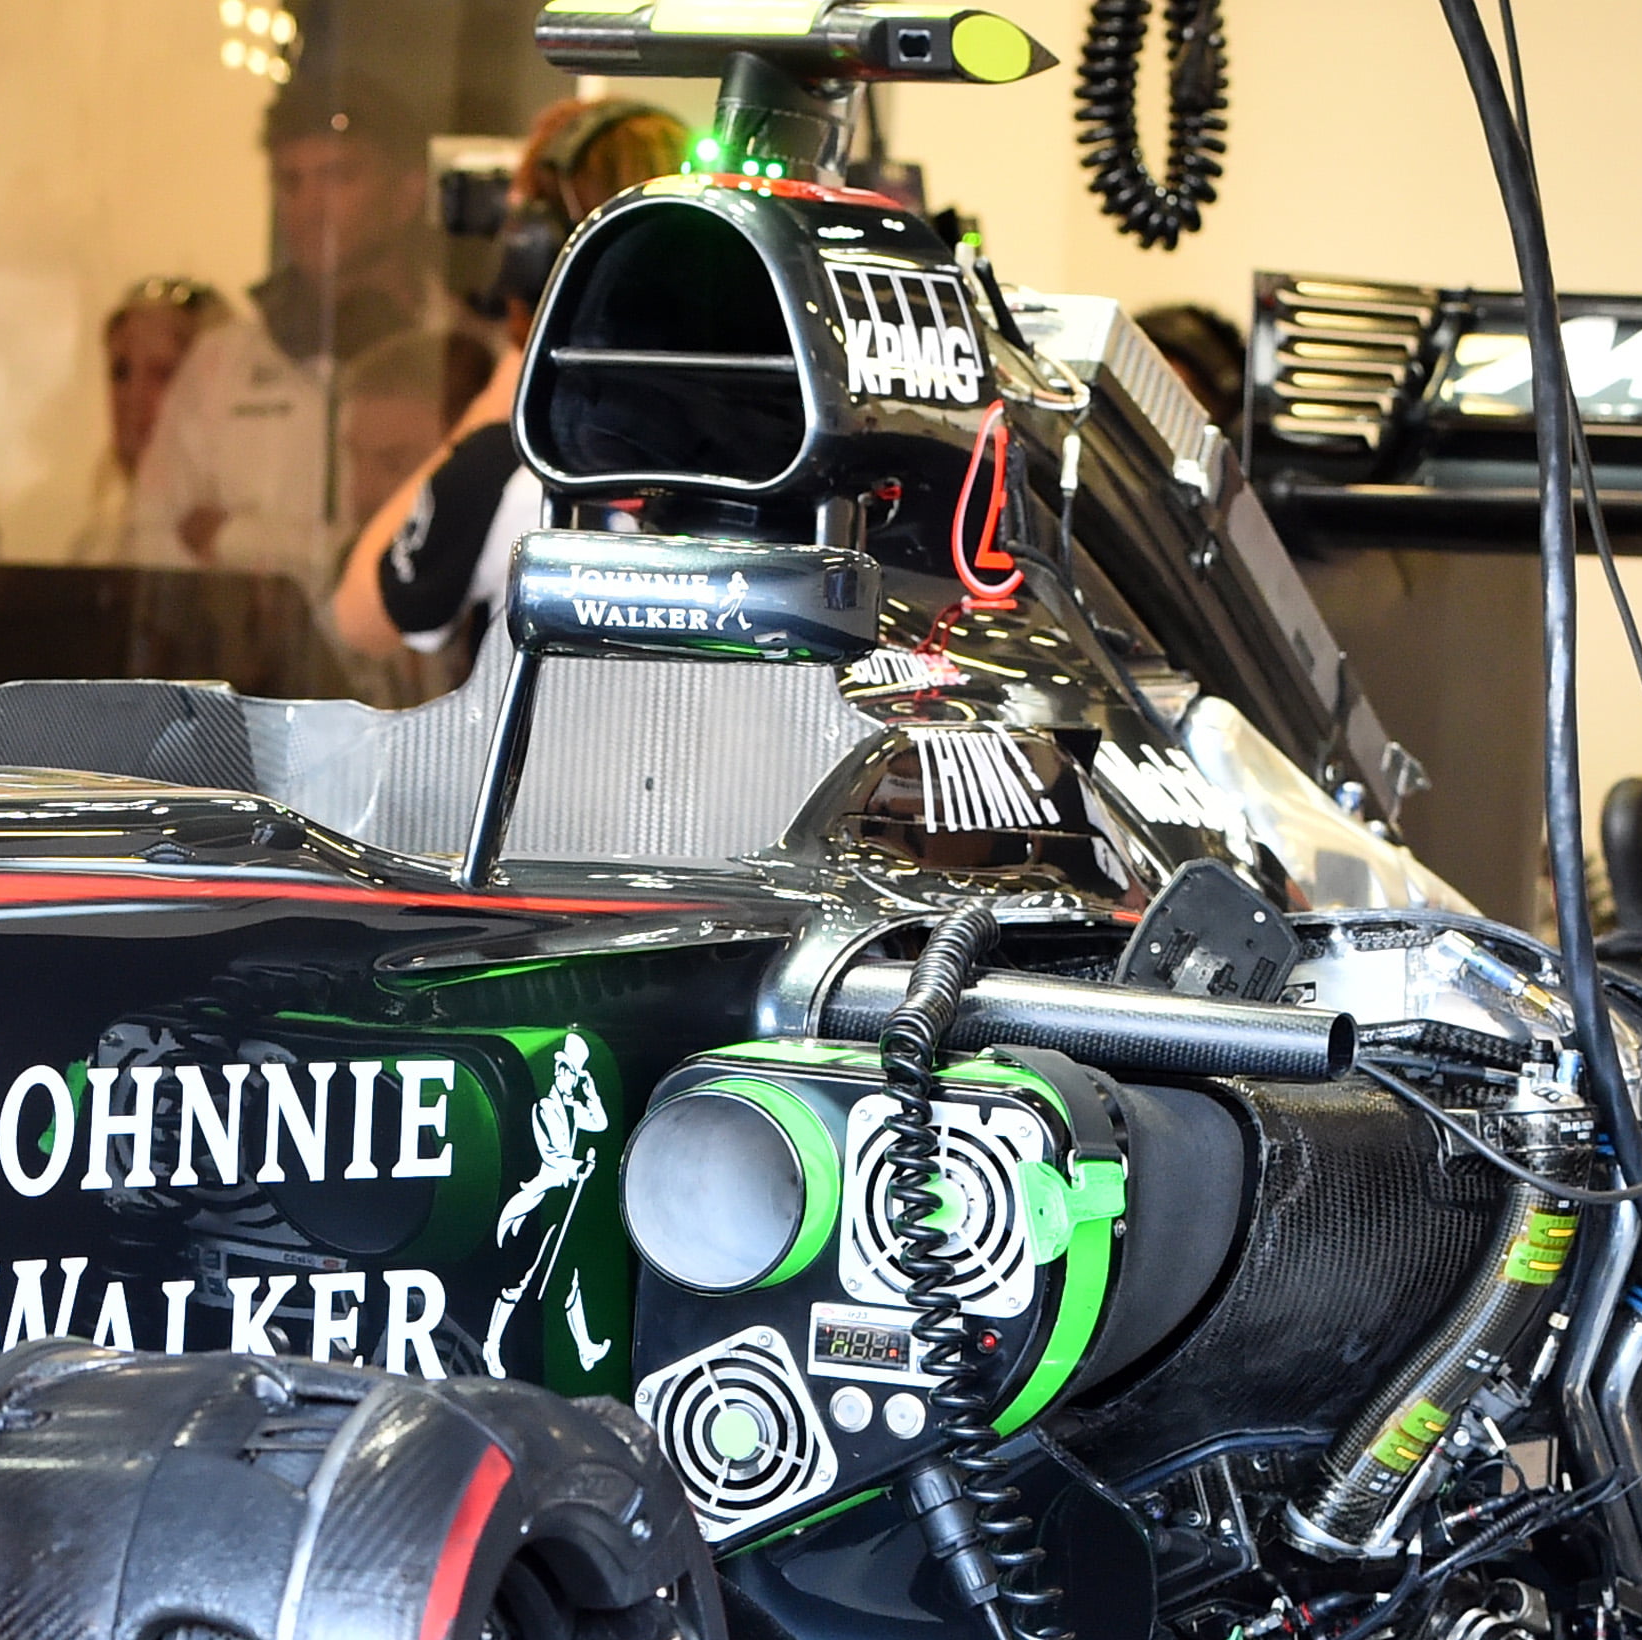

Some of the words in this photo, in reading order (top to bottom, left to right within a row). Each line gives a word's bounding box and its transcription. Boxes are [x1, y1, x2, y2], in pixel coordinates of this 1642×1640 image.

[843, 317, 980, 404] KPMG
[572, 598, 709, 631] WALKER
[906, 720, 1061, 834] THINK!
